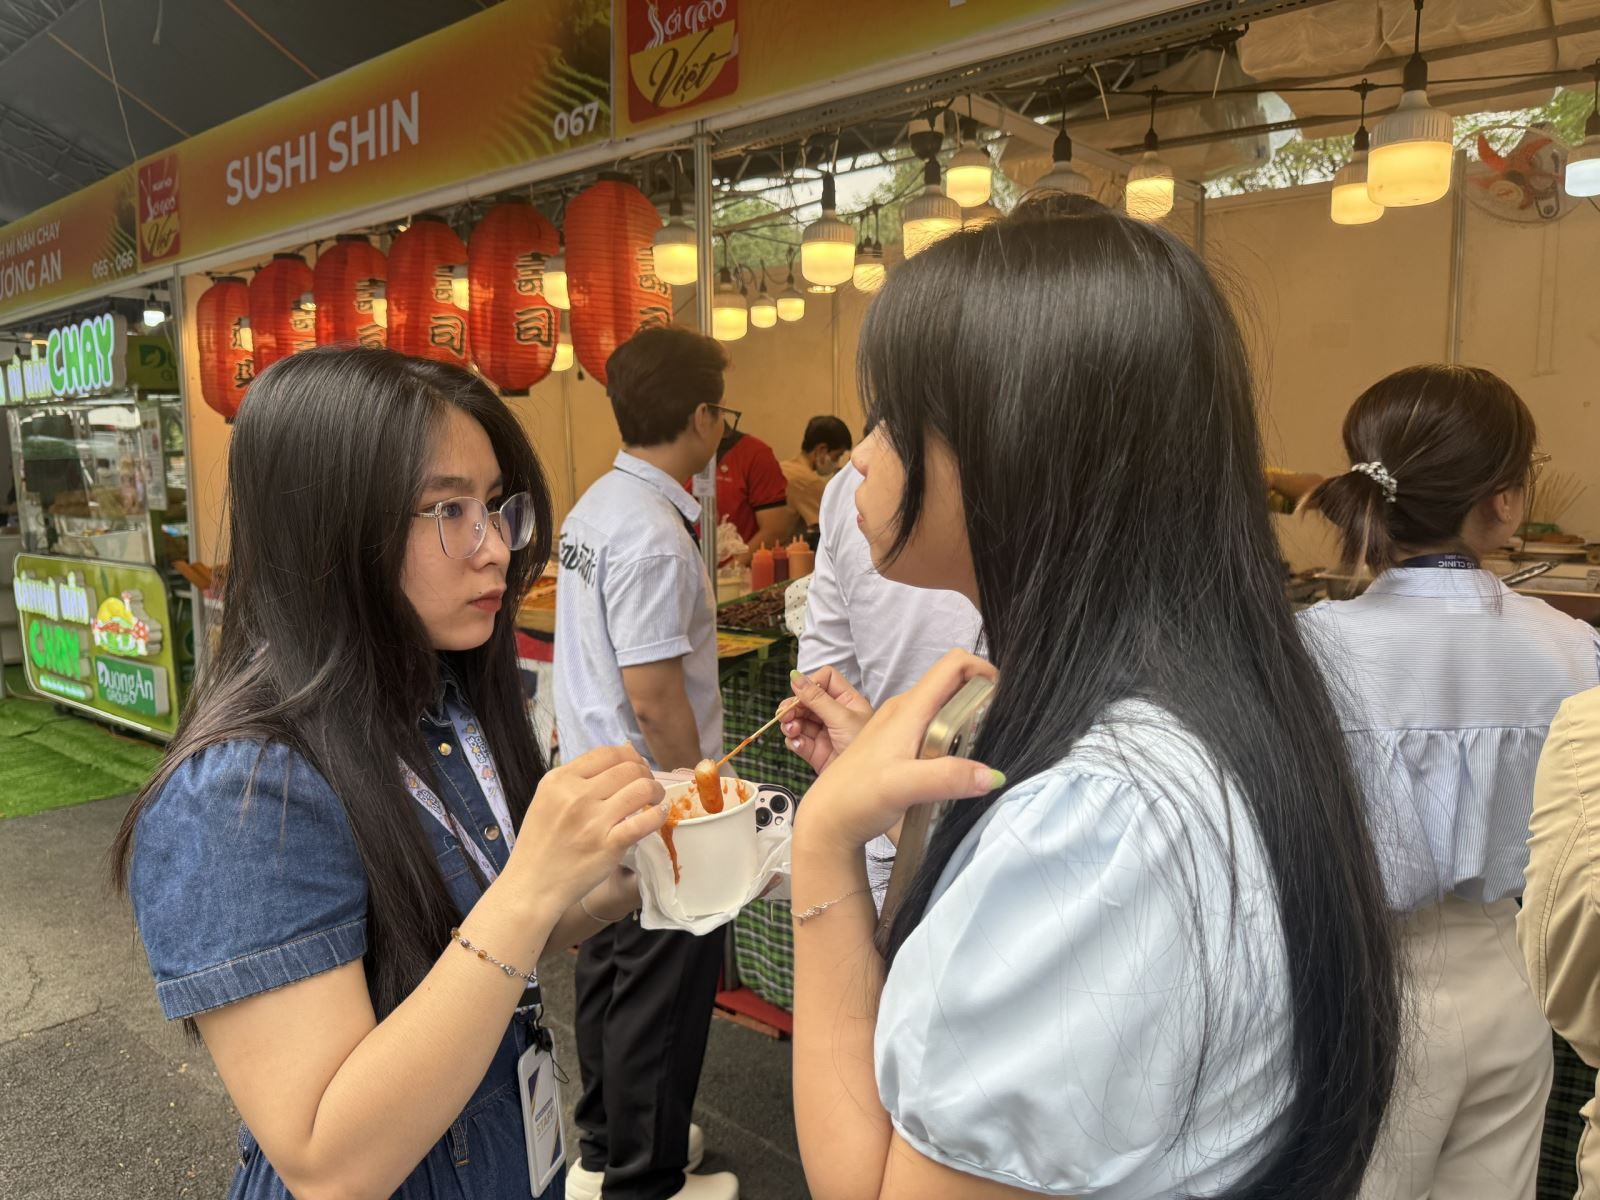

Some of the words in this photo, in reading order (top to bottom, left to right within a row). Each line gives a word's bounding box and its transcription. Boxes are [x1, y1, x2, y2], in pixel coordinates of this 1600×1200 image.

[648, 28, 731, 107] Việt
[553, 101, 600, 142] 067
[225, 131, 317, 206] SUSHI
[328, 91, 419, 173] SHIN
[37, 220, 60, 245] CHAY
[39, 248, 62, 288] AN
[92, 259, 109, 279] 065
[115, 249, 134, 272] 066
[47, 313, 115, 397] CHAY
[536, 1105, 554, 1137] STAFF
